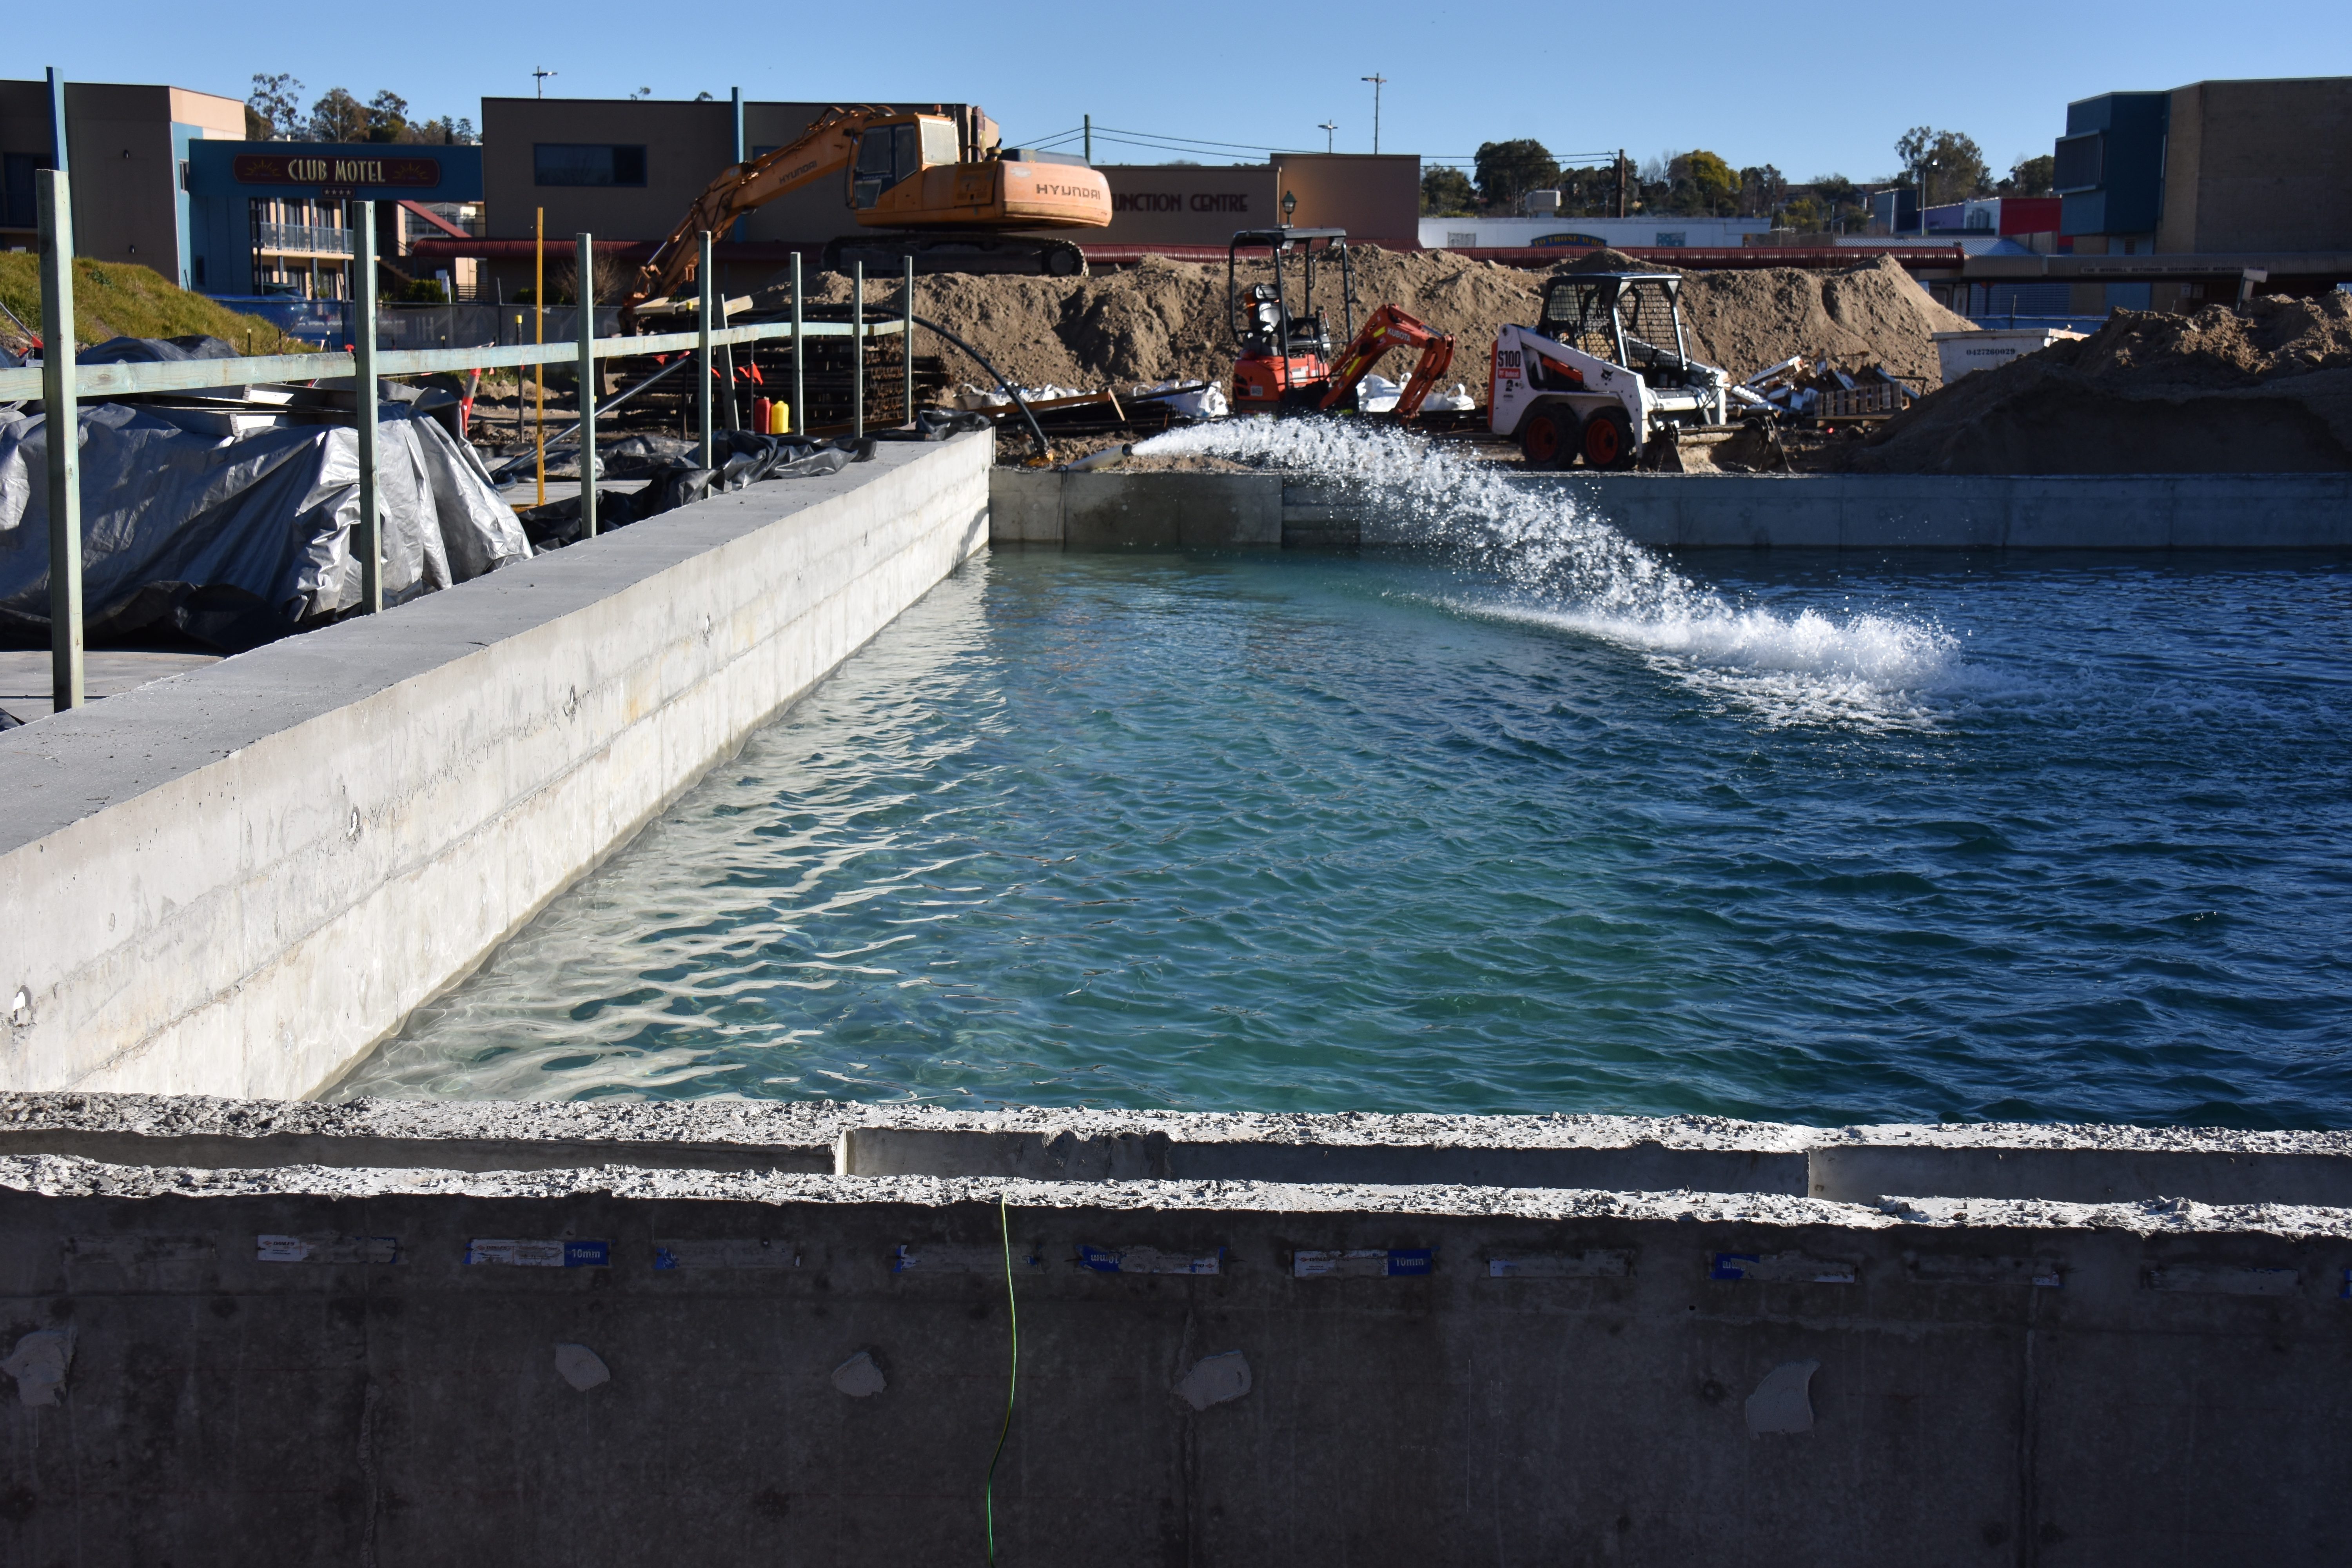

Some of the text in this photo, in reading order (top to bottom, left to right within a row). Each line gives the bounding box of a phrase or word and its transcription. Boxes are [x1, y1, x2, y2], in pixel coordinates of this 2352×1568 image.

[288, 159, 386, 183] CLUB MOTEL
[779, 160, 817, 185] HYUNDAI
[1036, 184, 1100, 200] HYUNDAI
[1111, 193, 1248, 212] UNCTION CENTRE
[1387, 327, 1411, 343] KUBOTA
[1498, 350, 1521, 367] S100
[1506, 379, 1513, 392] 2
[571, 1249, 601, 1258] 10mm
[1396, 1257, 1424, 1267] 10mm
